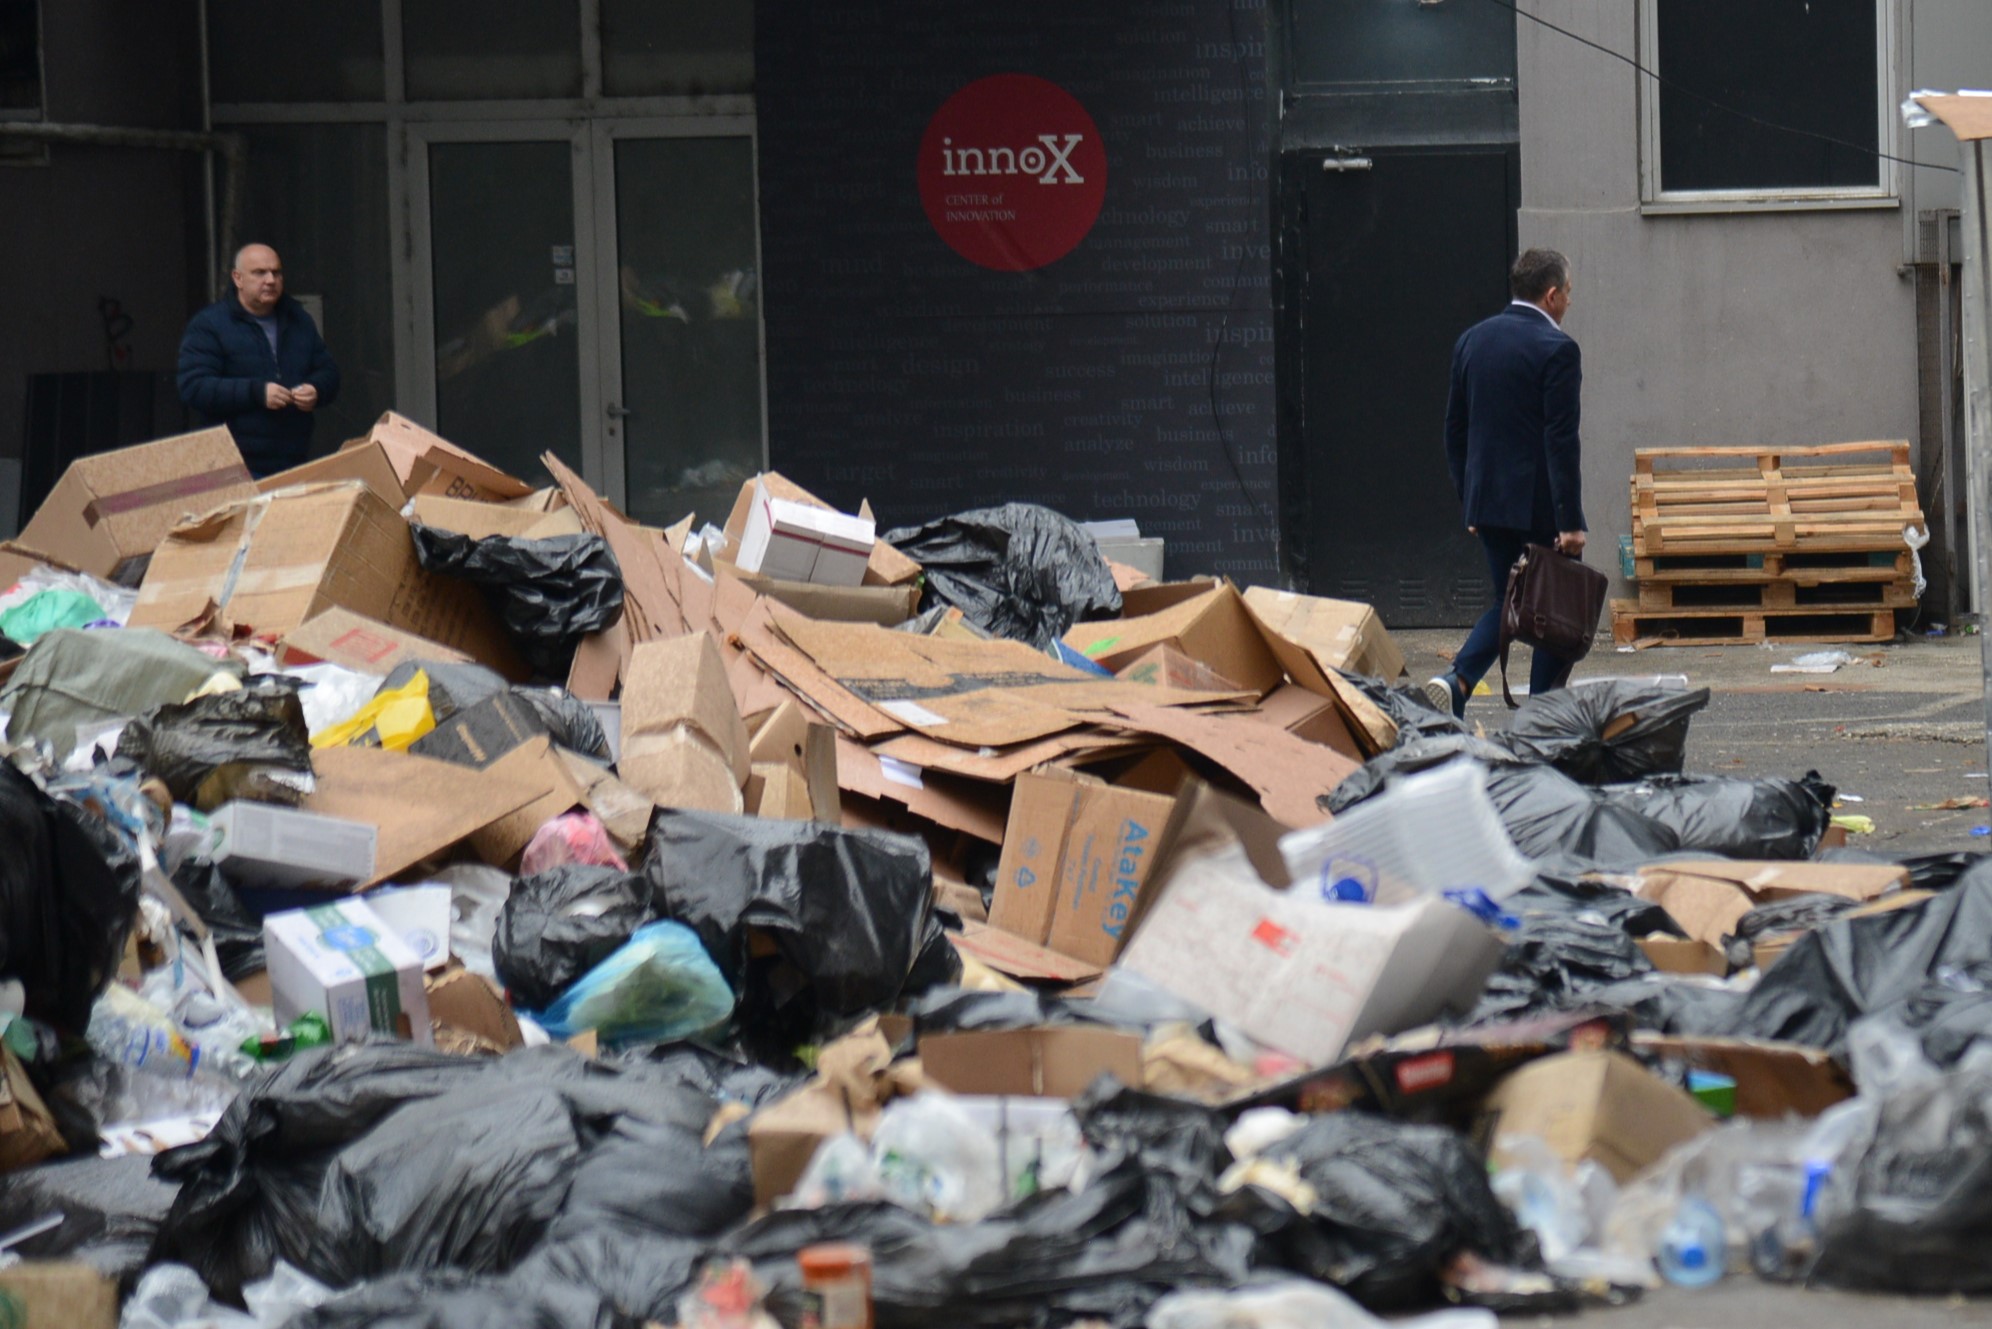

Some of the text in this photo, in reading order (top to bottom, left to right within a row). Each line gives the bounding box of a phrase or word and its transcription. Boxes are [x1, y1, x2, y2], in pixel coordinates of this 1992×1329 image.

[1114, 28, 1187, 45] solution
[1177, 115, 1246, 133] achieve
[943, 134, 1084, 184] innoX
[1146, 142, 1224, 159] business
[1132, 172, 1198, 189] wisdom
[946, 193, 1003, 206] CENTER of
[946, 210, 1016, 223] INNOVATION
[1101, 256, 1212, 275] development
[1059, 280, 1154, 298] performance
[1138, 293, 1230, 310] experience
[1125, 314, 1198, 330] solution
[901, 353, 980, 379] design
[1045, 364, 1117, 379] success
[1164, 367, 1274, 389] inteligence
[1004, 387, 1082, 403] business
[1121, 396, 1175, 412] smart
[1063, 412, 1144, 430] creativity
[932, 419, 1046, 443] inspiration
[1064, 434, 1135, 455] analyze
[1144, 456, 1210, 473] wisdom
[1092, 488, 1202, 511] technology
[1215, 502, 1270, 517] smat
[1102, 818, 1149, 940] AtaKey
